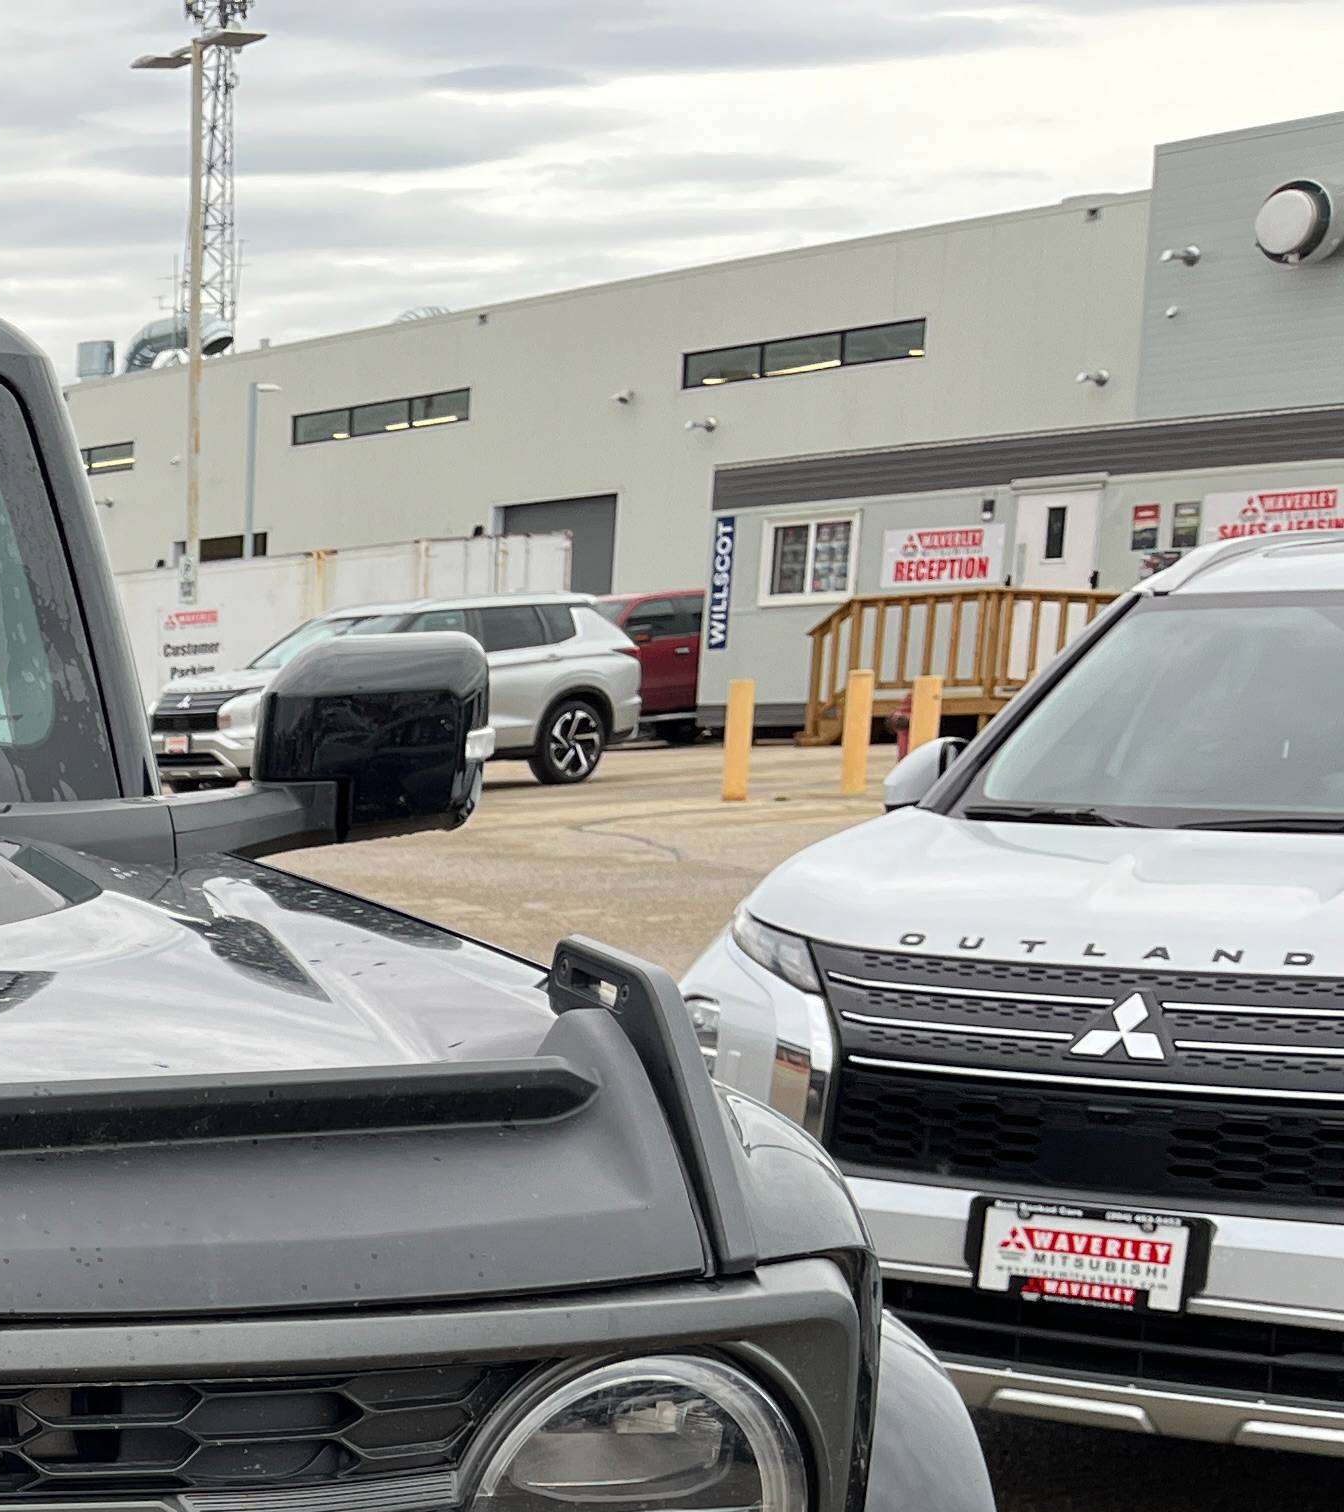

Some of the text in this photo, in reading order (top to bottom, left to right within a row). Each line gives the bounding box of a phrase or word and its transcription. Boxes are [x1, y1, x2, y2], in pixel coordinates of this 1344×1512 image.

[709, 521, 733, 645] WILLSCOT
[894, 556, 990, 582] RECEPTION
[1032, 1230, 1171, 1263] WAVERLEY
[1032, 1252, 1169, 1280] MITSUBISHI
[1043, 1278, 1135, 1303] WAVERLEY
